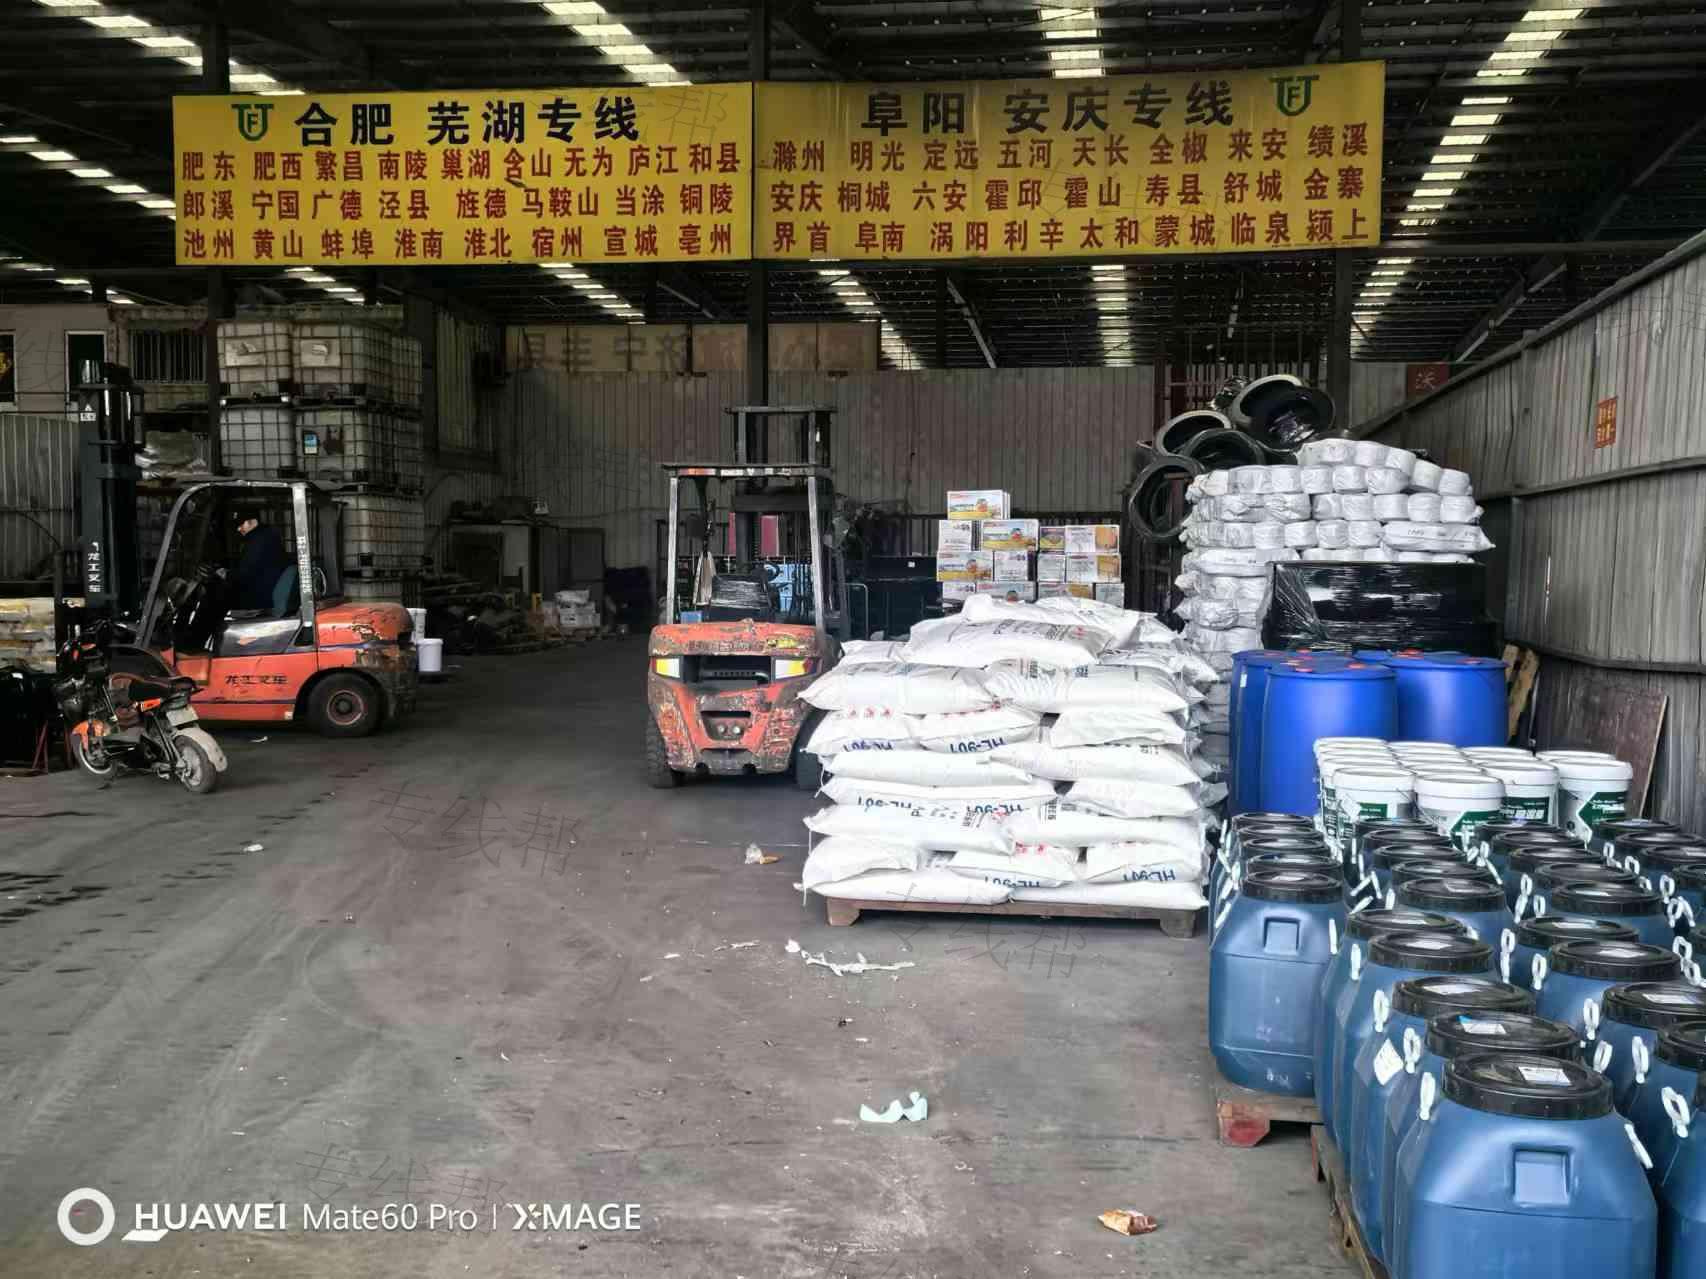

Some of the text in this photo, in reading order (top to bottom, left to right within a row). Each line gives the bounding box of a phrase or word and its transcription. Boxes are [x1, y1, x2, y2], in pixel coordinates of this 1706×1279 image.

[295, 97, 639, 146] 合肥 芜湖专线
[861, 80, 1234, 136] 阜阳 安庆专线
[183, 151, 235, 181] 肥东
[254, 152, 302, 180] 肥西
[315, 151, 363, 181] 繁昌
[378, 150, 427, 180] 南陵
[442, 149, 490, 180] 巢湖
[565, 146, 612, 176] 无为
[628, 145, 678, 176] 庐江
[689, 142, 740, 174] 和县
[773, 123, 1367, 172] 滁州 明光 定远 五河 天长 全椒 来安 绩溪
[184, 183, 732, 220] 郎溪 宁国 广德 泾县 旌德 马鞍山 当涂 铜陵
[771, 165, 1363, 212] 安庆 桐城 六安 霍邱 霍山 寿县 舒城 金寨
[184, 229, 234, 258] 池州
[253, 229, 303, 259] 黄山
[322, 228, 374, 259] 蚌埠
[395, 228, 443, 259] 淮南
[464, 228, 512, 258] 淮北
[532, 227, 581, 257] 宿州
[604, 224, 658, 256] 宣城
[773, 221, 830, 253] 界首
[855, 221, 904, 253] 阜南
[931, 222, 988, 252] 涡阳
[1004, 218, 1063, 251] 利辛
[1080, 217, 1139, 248] 太和
[1155, 213, 1215, 247] 蒙城
[1232, 211, 1290, 246] 临泉
